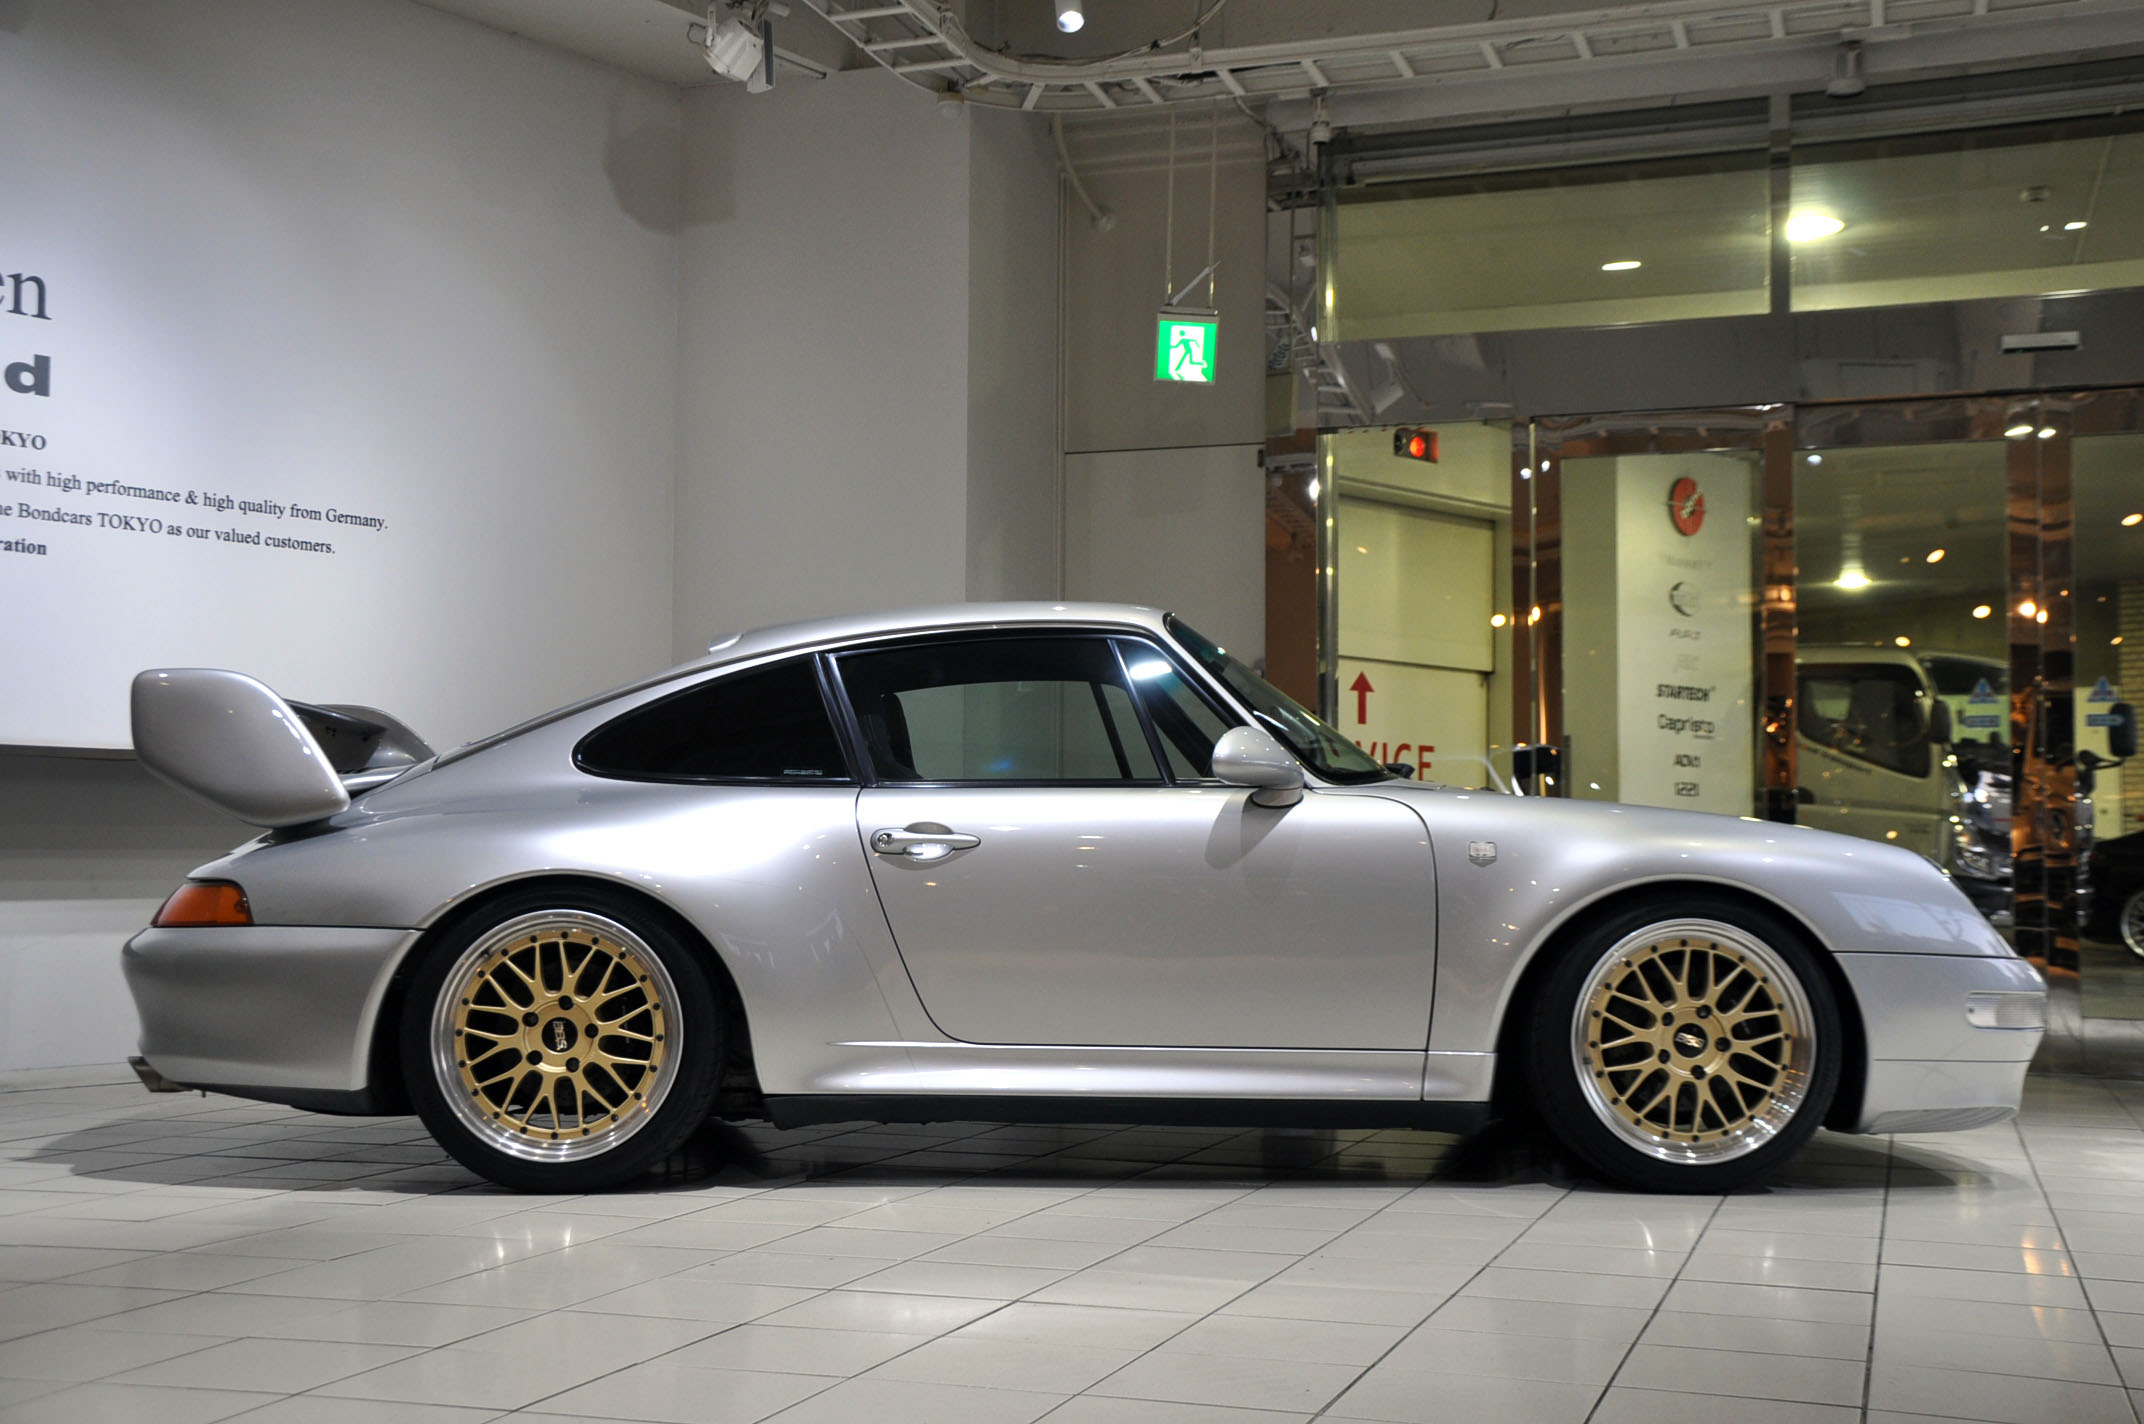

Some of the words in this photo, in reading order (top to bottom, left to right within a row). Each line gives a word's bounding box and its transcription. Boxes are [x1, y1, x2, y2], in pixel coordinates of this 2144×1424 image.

[0, 272, 53, 320] n
[5, 467, 42, 485] with
[46, 471, 82, 492] high
[86, 480, 181, 502] performance
[185, 490, 199, 505] &
[203, 492, 235, 512] high
[238, 499, 286, 520] quality
[290, 503, 322, 520] from
[325, 508, 388, 531] Germany.
[18, 502, 93, 526] Bondcars
[97, 512, 163, 534] TOKYO
[167, 524, 182, 536] as
[186, 527, 211, 539] our
[214, 528, 261, 545] valued
[264, 535, 336, 554] customers.
